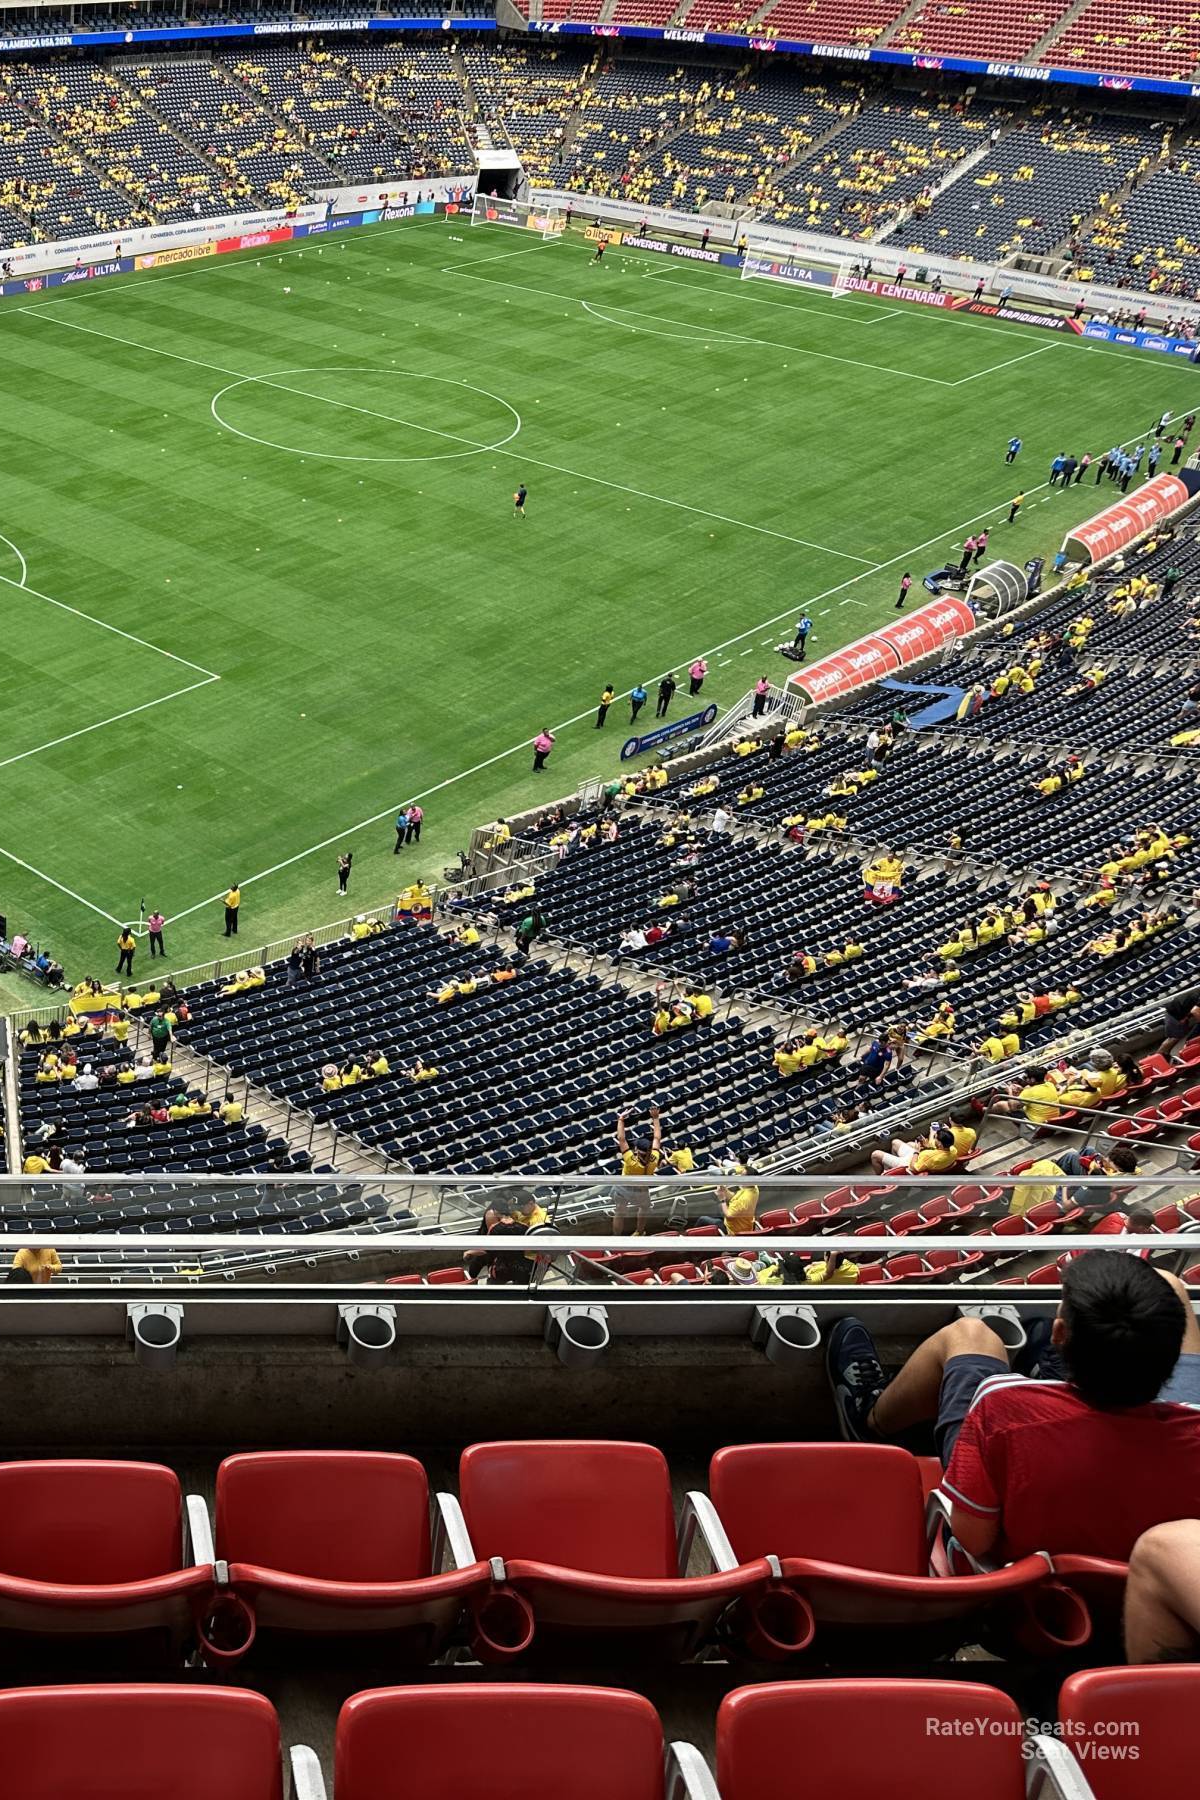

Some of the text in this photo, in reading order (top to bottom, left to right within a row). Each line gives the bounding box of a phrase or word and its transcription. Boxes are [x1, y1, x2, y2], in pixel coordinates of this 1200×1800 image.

[291, 23, 308, 32] COPA
[8, 38, 40, 49] AMERICA
[55, 36, 72, 46] 2024
[663, 30, 705, 43] WELCOME
[812, 45, 870, 60] BIENVENIDOS
[986, 63, 1051, 80] BEM-VINDOS
[384, 206, 415, 220] Rexona
[593, 227, 613, 239] libre
[622, 235, 668, 252] POWERADE
[158, 244, 211, 263] mercado libre
[672, 245, 720, 262] POWERADE
[94, 263, 121, 274] ULTRA
[779, 265, 813, 280] ULTRA
[838, 276, 945, 306] TEQUILA CENTENARIO
[969, 303, 999, 316] INTER
[895, 625, 925, 646] Betano
[851, 649, 882, 669] Betano
[809, 670, 842, 692] Betano
